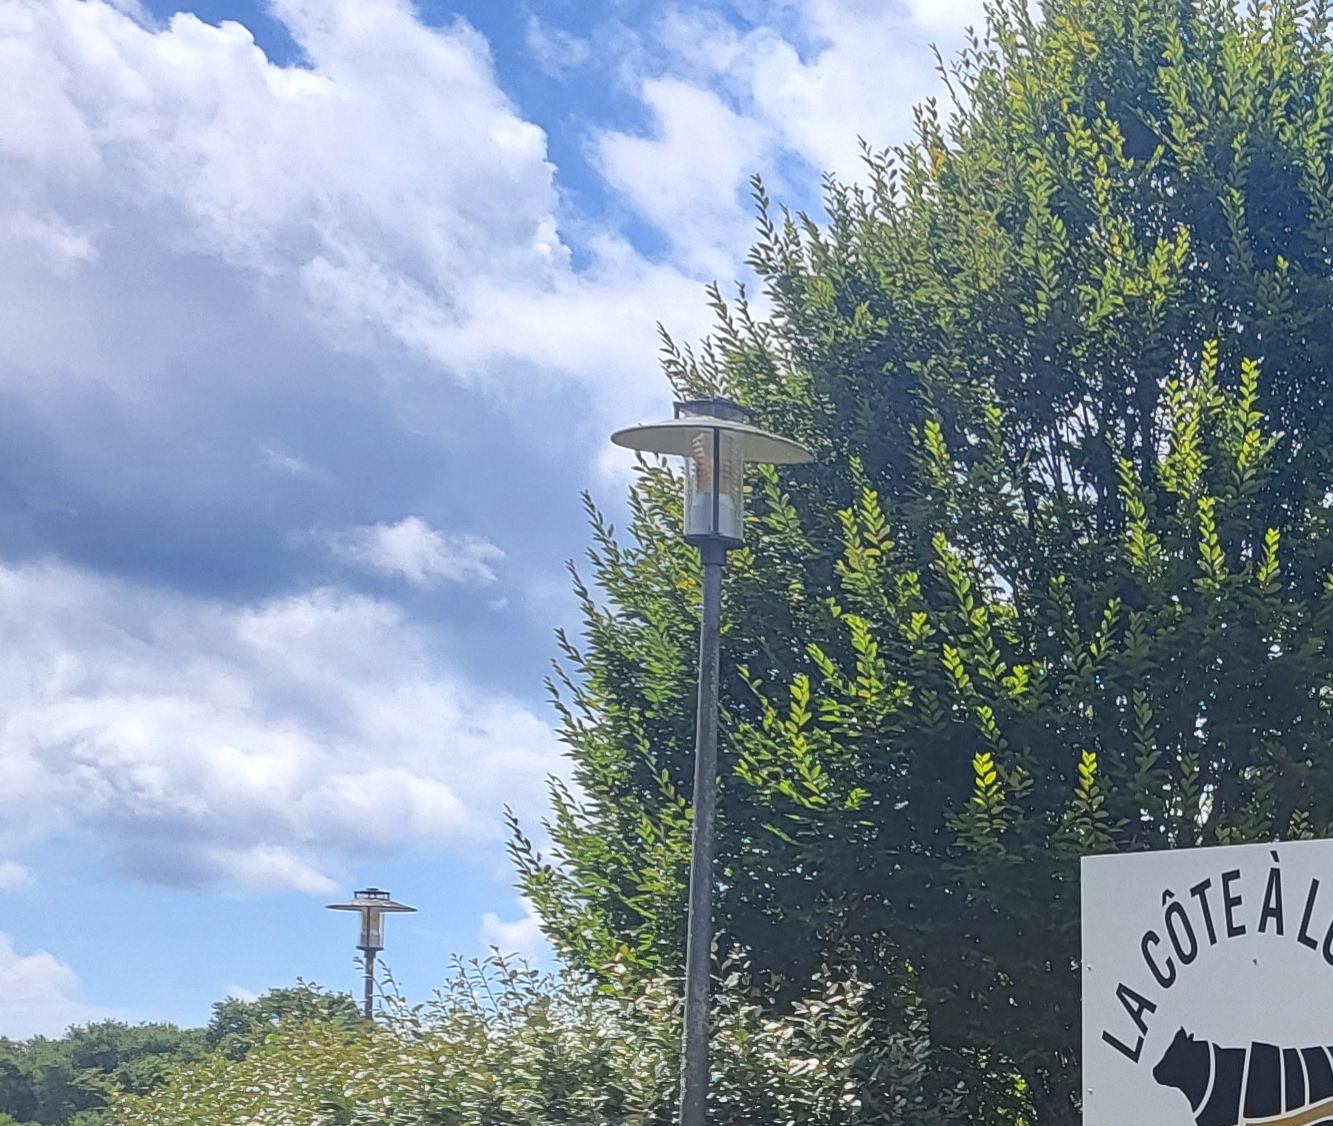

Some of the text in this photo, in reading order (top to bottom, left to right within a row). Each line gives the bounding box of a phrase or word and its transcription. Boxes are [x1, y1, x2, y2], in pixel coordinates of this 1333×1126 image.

[1101, 982, 1157, 1064] LA
[1141, 869, 1246, 989] CÔTE
[1257, 850, 1285, 936] À
